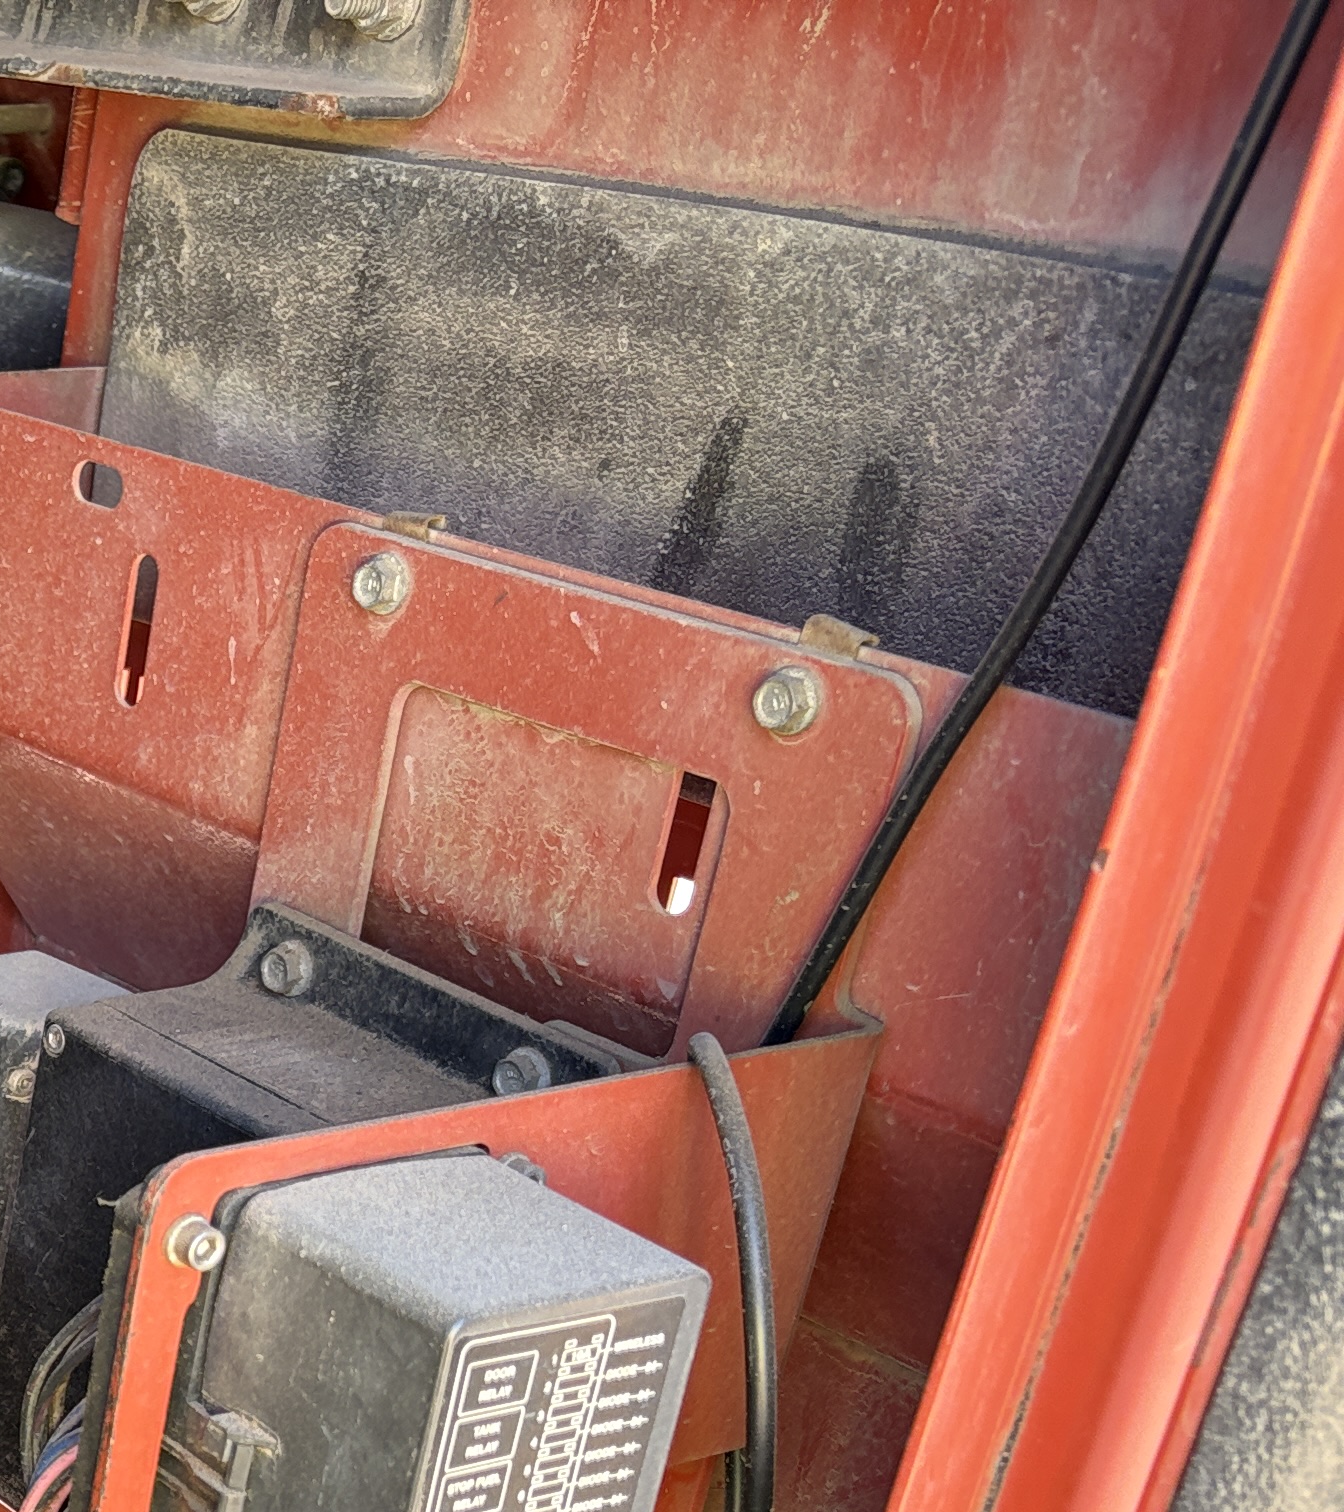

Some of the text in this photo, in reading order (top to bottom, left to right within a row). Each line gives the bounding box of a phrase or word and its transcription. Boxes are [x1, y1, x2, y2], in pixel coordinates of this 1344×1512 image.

[483, 1364, 517, 1384] DOOR
[477, 1384, 513, 1405] RELAY
[473, 1420, 502, 1440] TANK
[464, 1440, 500, 1460] RELAY
[446, 1472, 502, 1498] STOP FUEL
